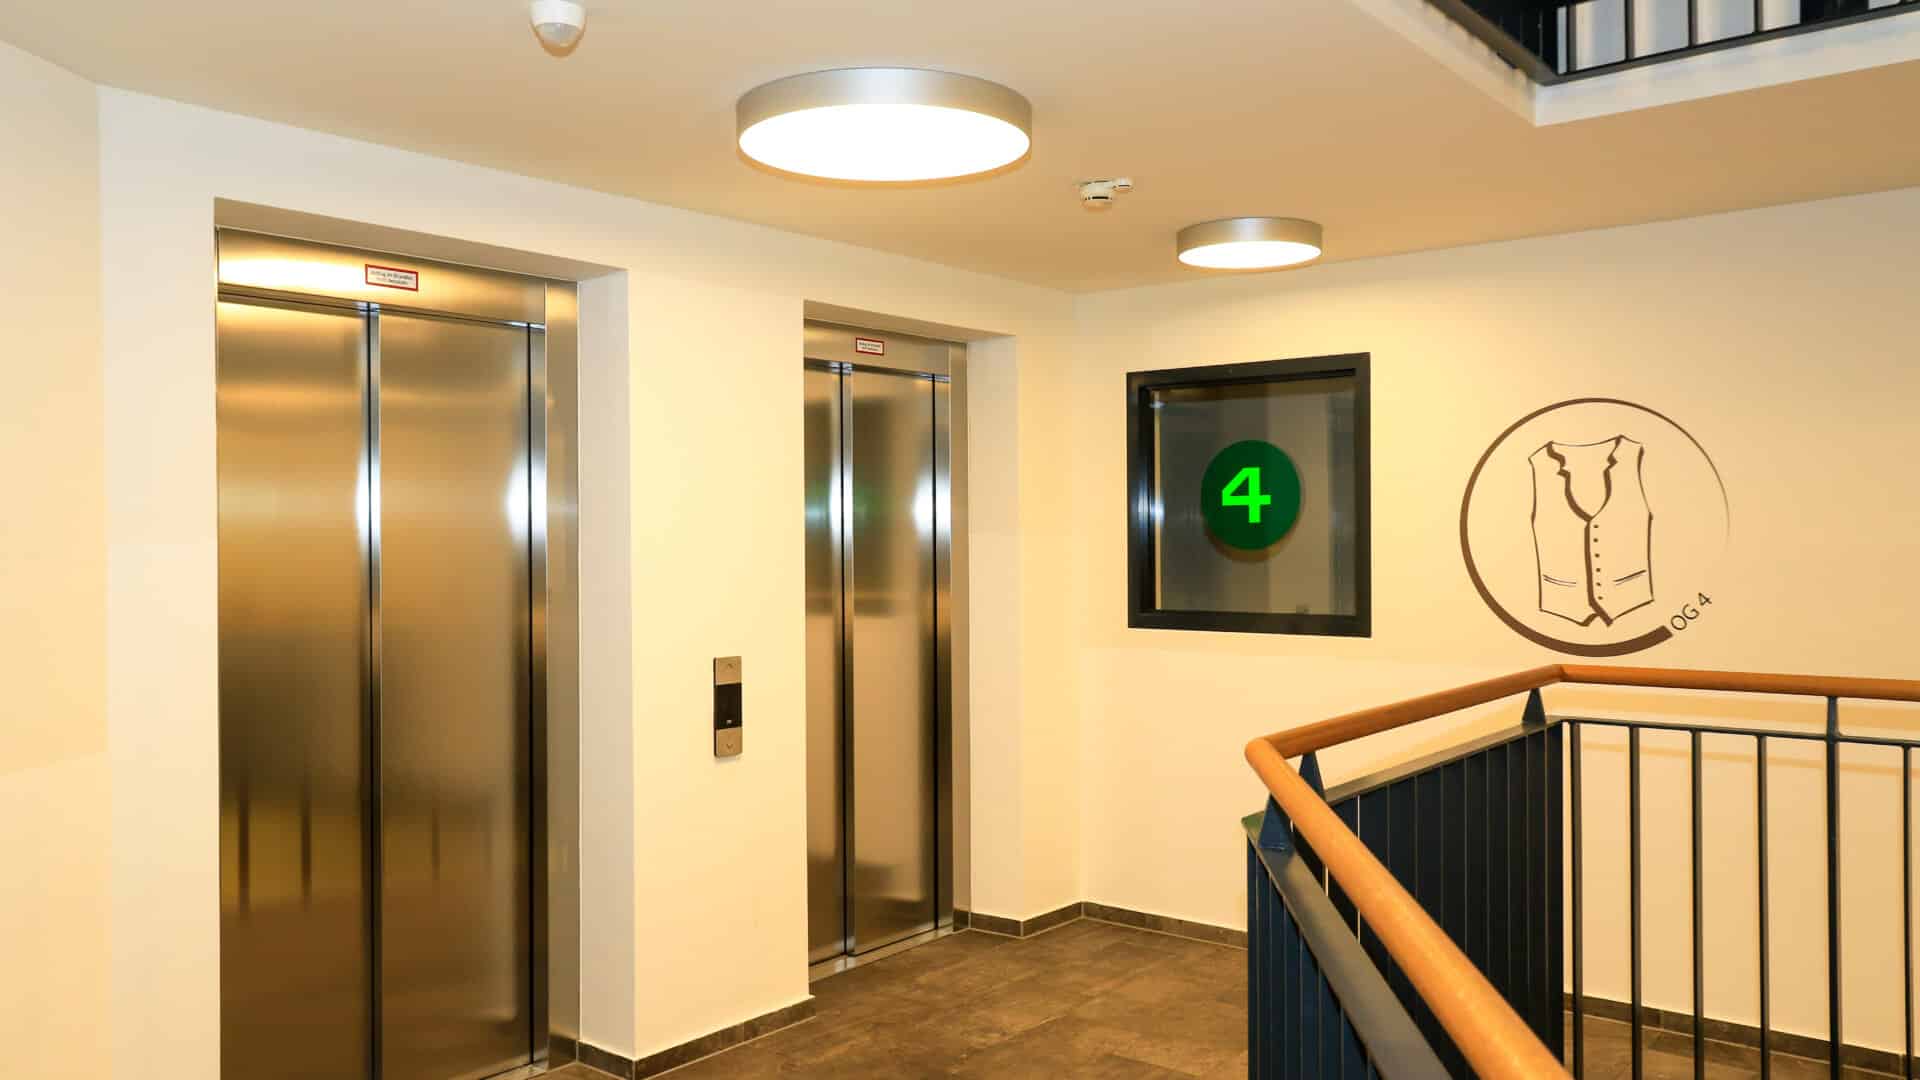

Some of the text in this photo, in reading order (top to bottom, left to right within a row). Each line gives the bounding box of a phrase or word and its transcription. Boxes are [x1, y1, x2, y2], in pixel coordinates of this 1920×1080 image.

[1221, 467, 1272, 523] 4
[1670, 592, 1713, 631] OG 4
